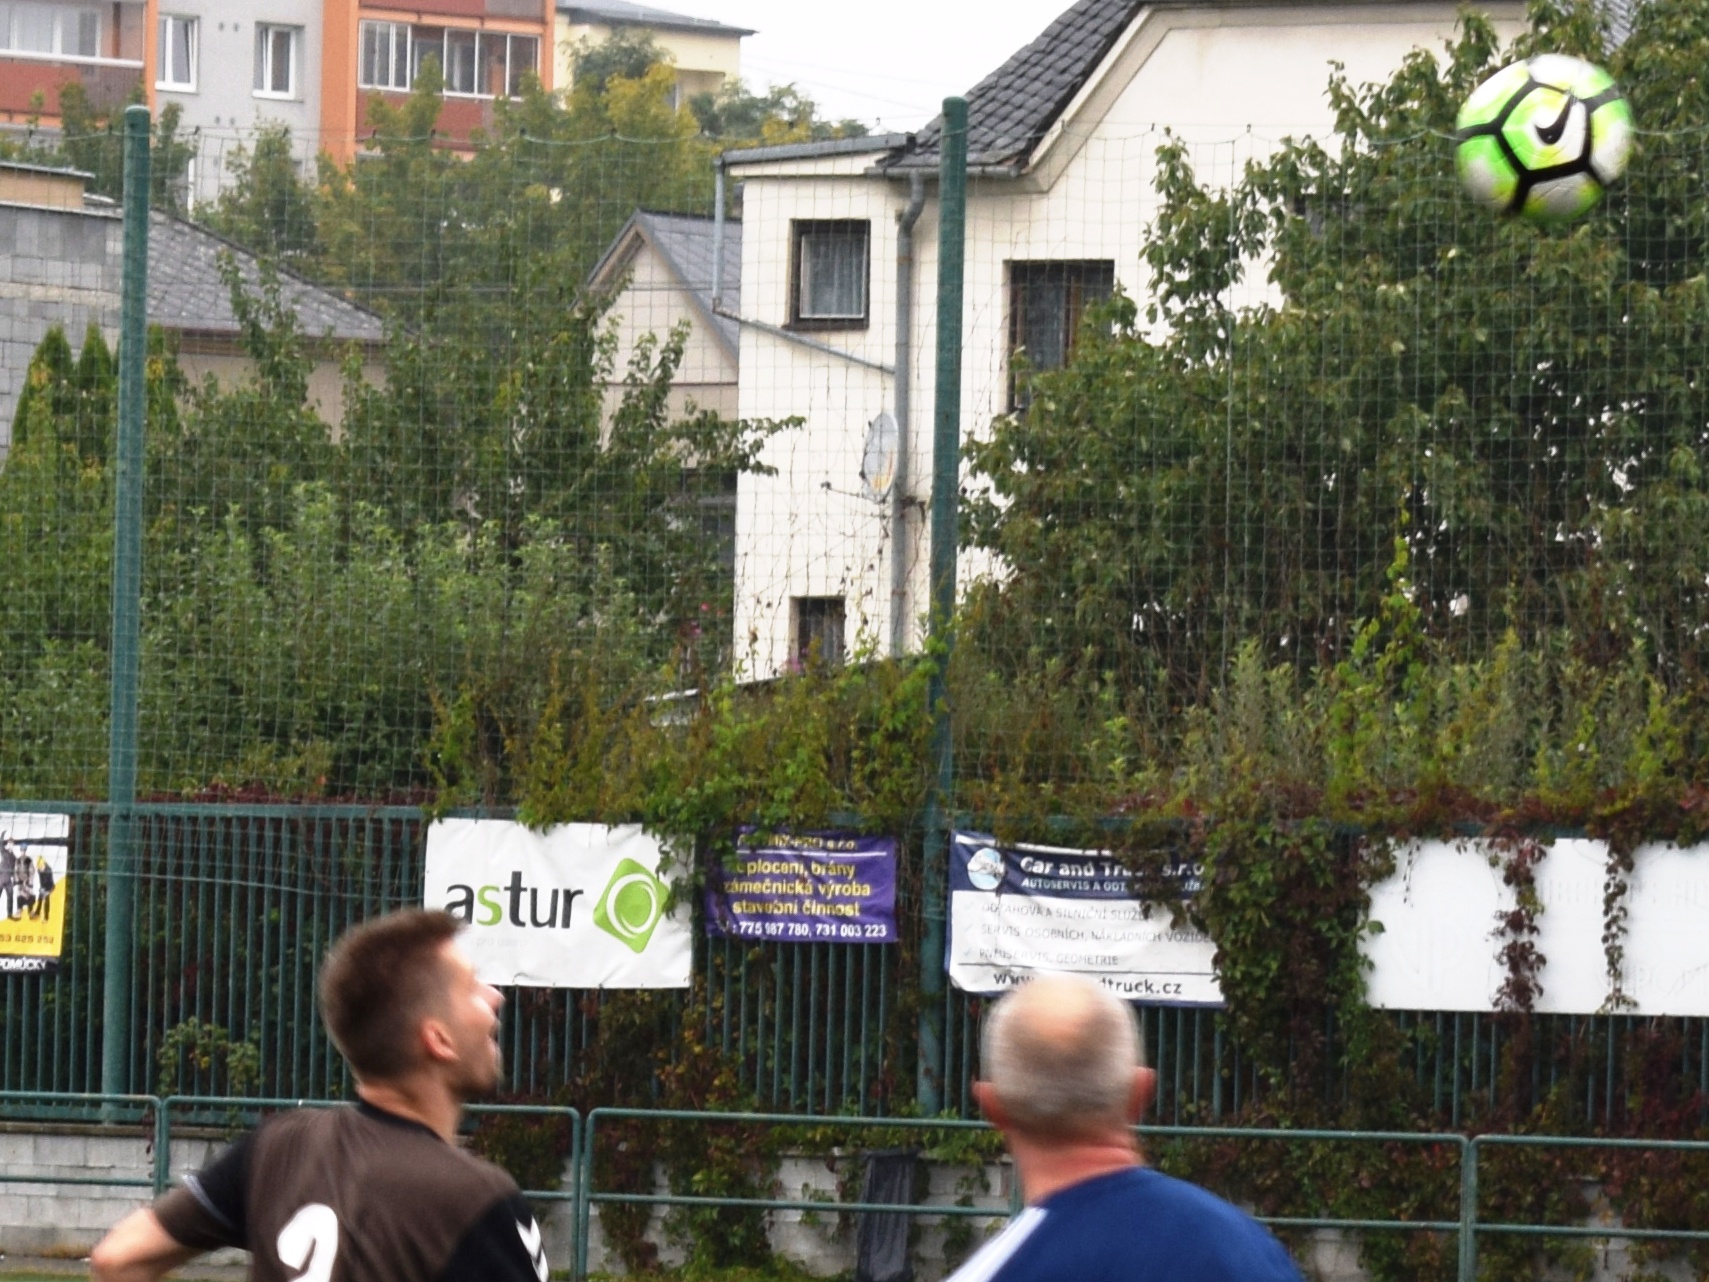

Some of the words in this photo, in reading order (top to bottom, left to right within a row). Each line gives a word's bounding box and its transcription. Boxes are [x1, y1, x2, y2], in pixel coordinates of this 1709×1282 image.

[811, 860, 856, 880] brány
[1020, 856, 1054, 874] Car
[1058, 861, 1095, 877] and
[817, 880, 871, 899] výroba
[1021, 877, 1090, 891] AUTOSERVIS
[1092, 881, 1101, 892] A
[445, 870, 584, 929] astur
[802, 900, 861, 916] činnost
[815, 923, 836, 936] 731
[840, 923, 862, 938] 003
[864, 923, 887, 938] 223
